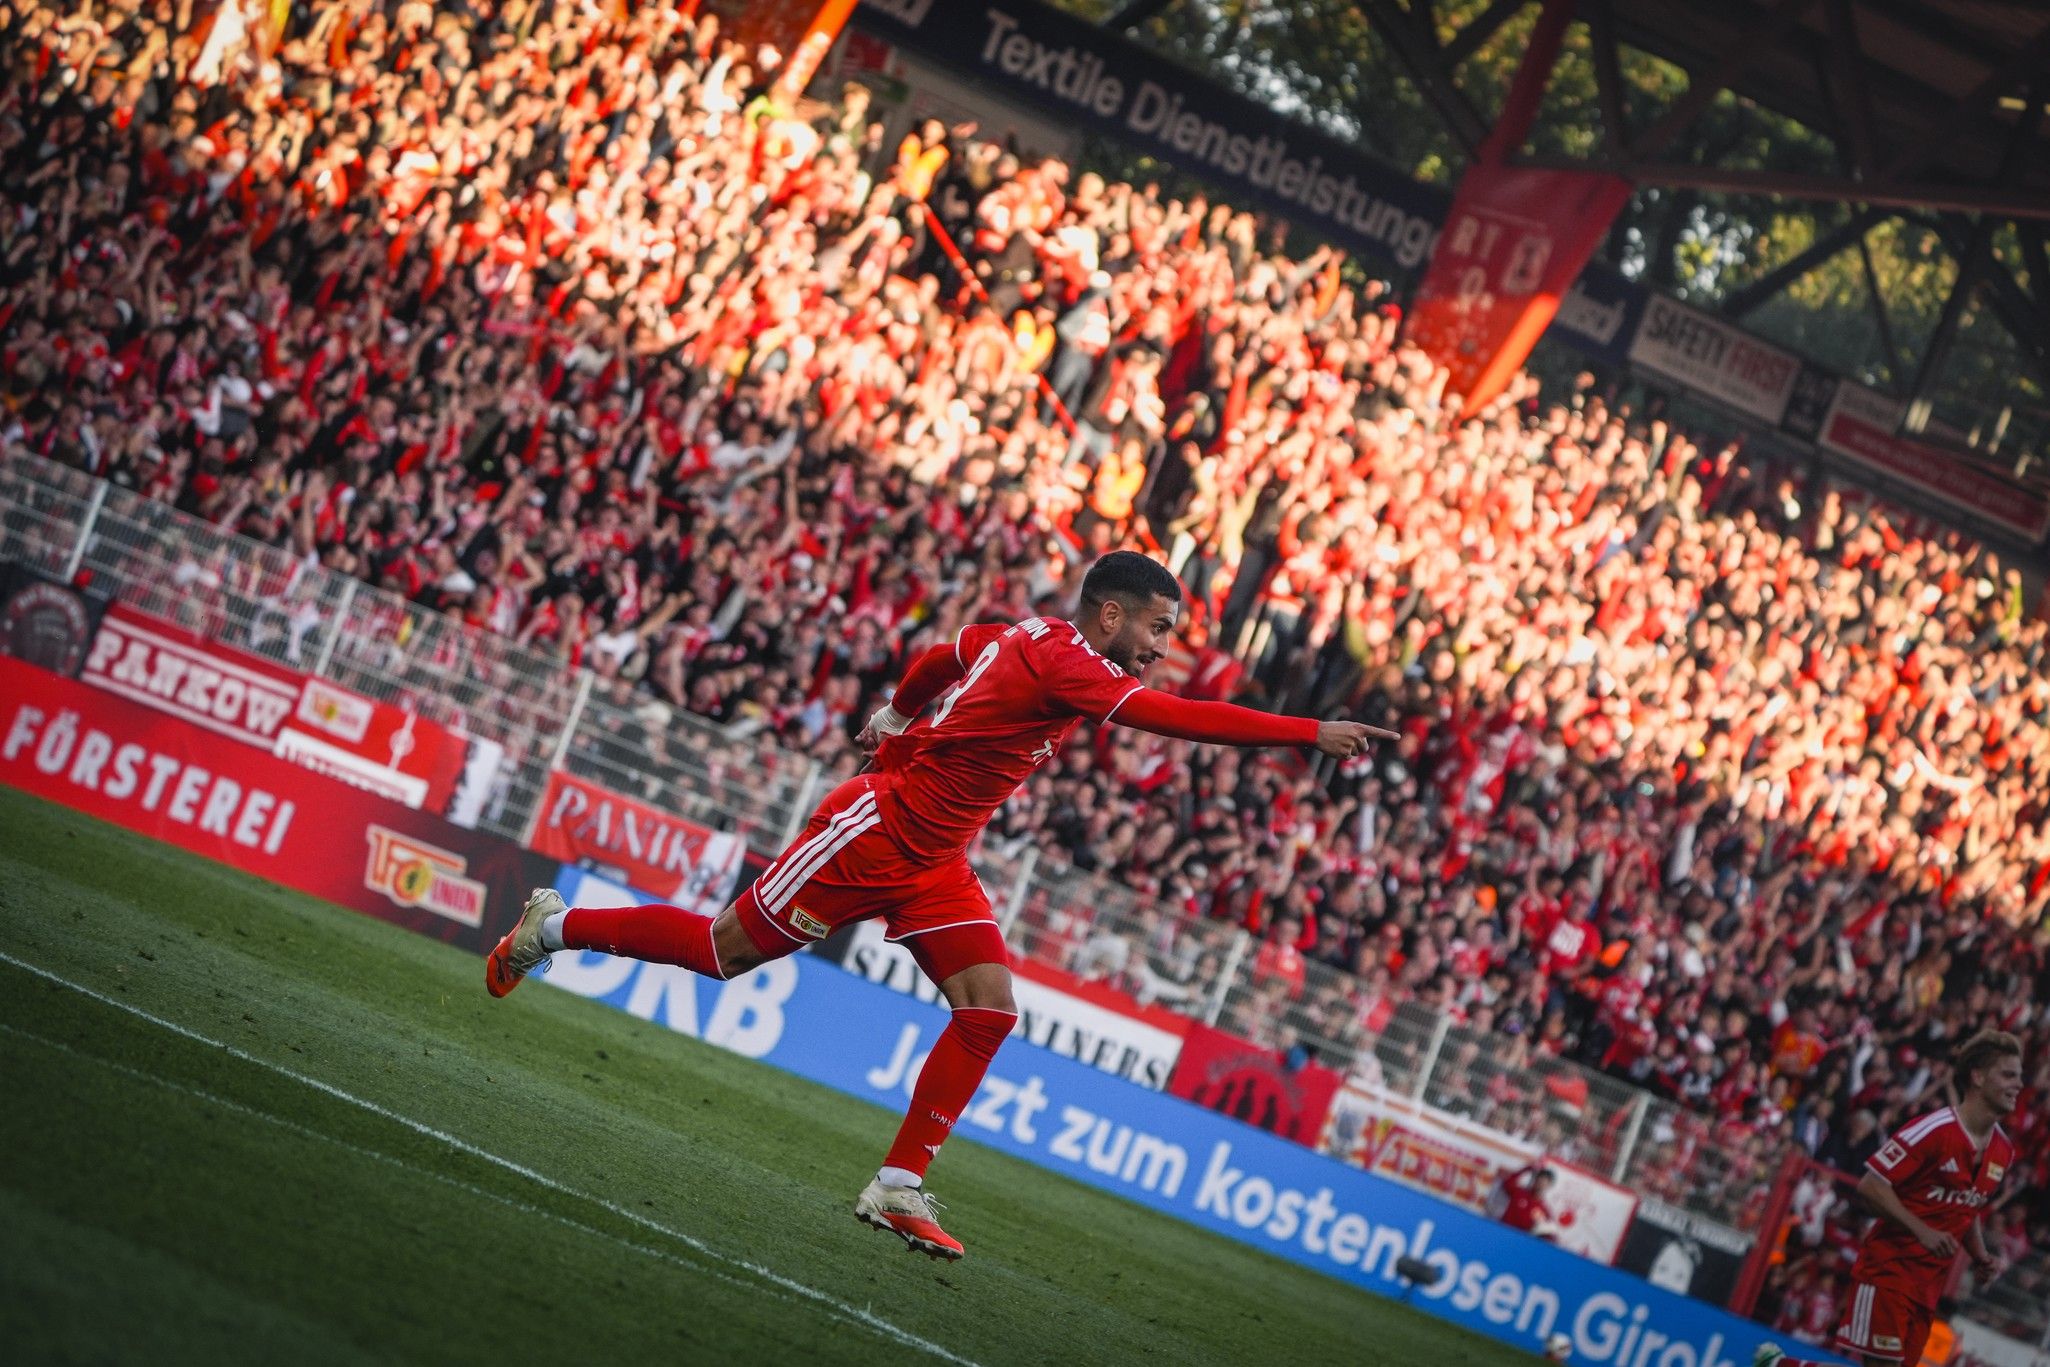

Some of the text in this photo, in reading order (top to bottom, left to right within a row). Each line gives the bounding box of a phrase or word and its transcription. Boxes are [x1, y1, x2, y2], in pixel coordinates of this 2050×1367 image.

[981, 8, 1120, 118] Textile
[86, 628, 292, 735] PANKOW
[3, 705, 296, 856] FÖRSTEREI
[549, 784, 701, 878] PANIK
[867, 1022, 1048, 1145] Jzt
[1051, 1105, 1189, 1198] zum
[1195, 1140, 1560, 1339] kostenlosen
